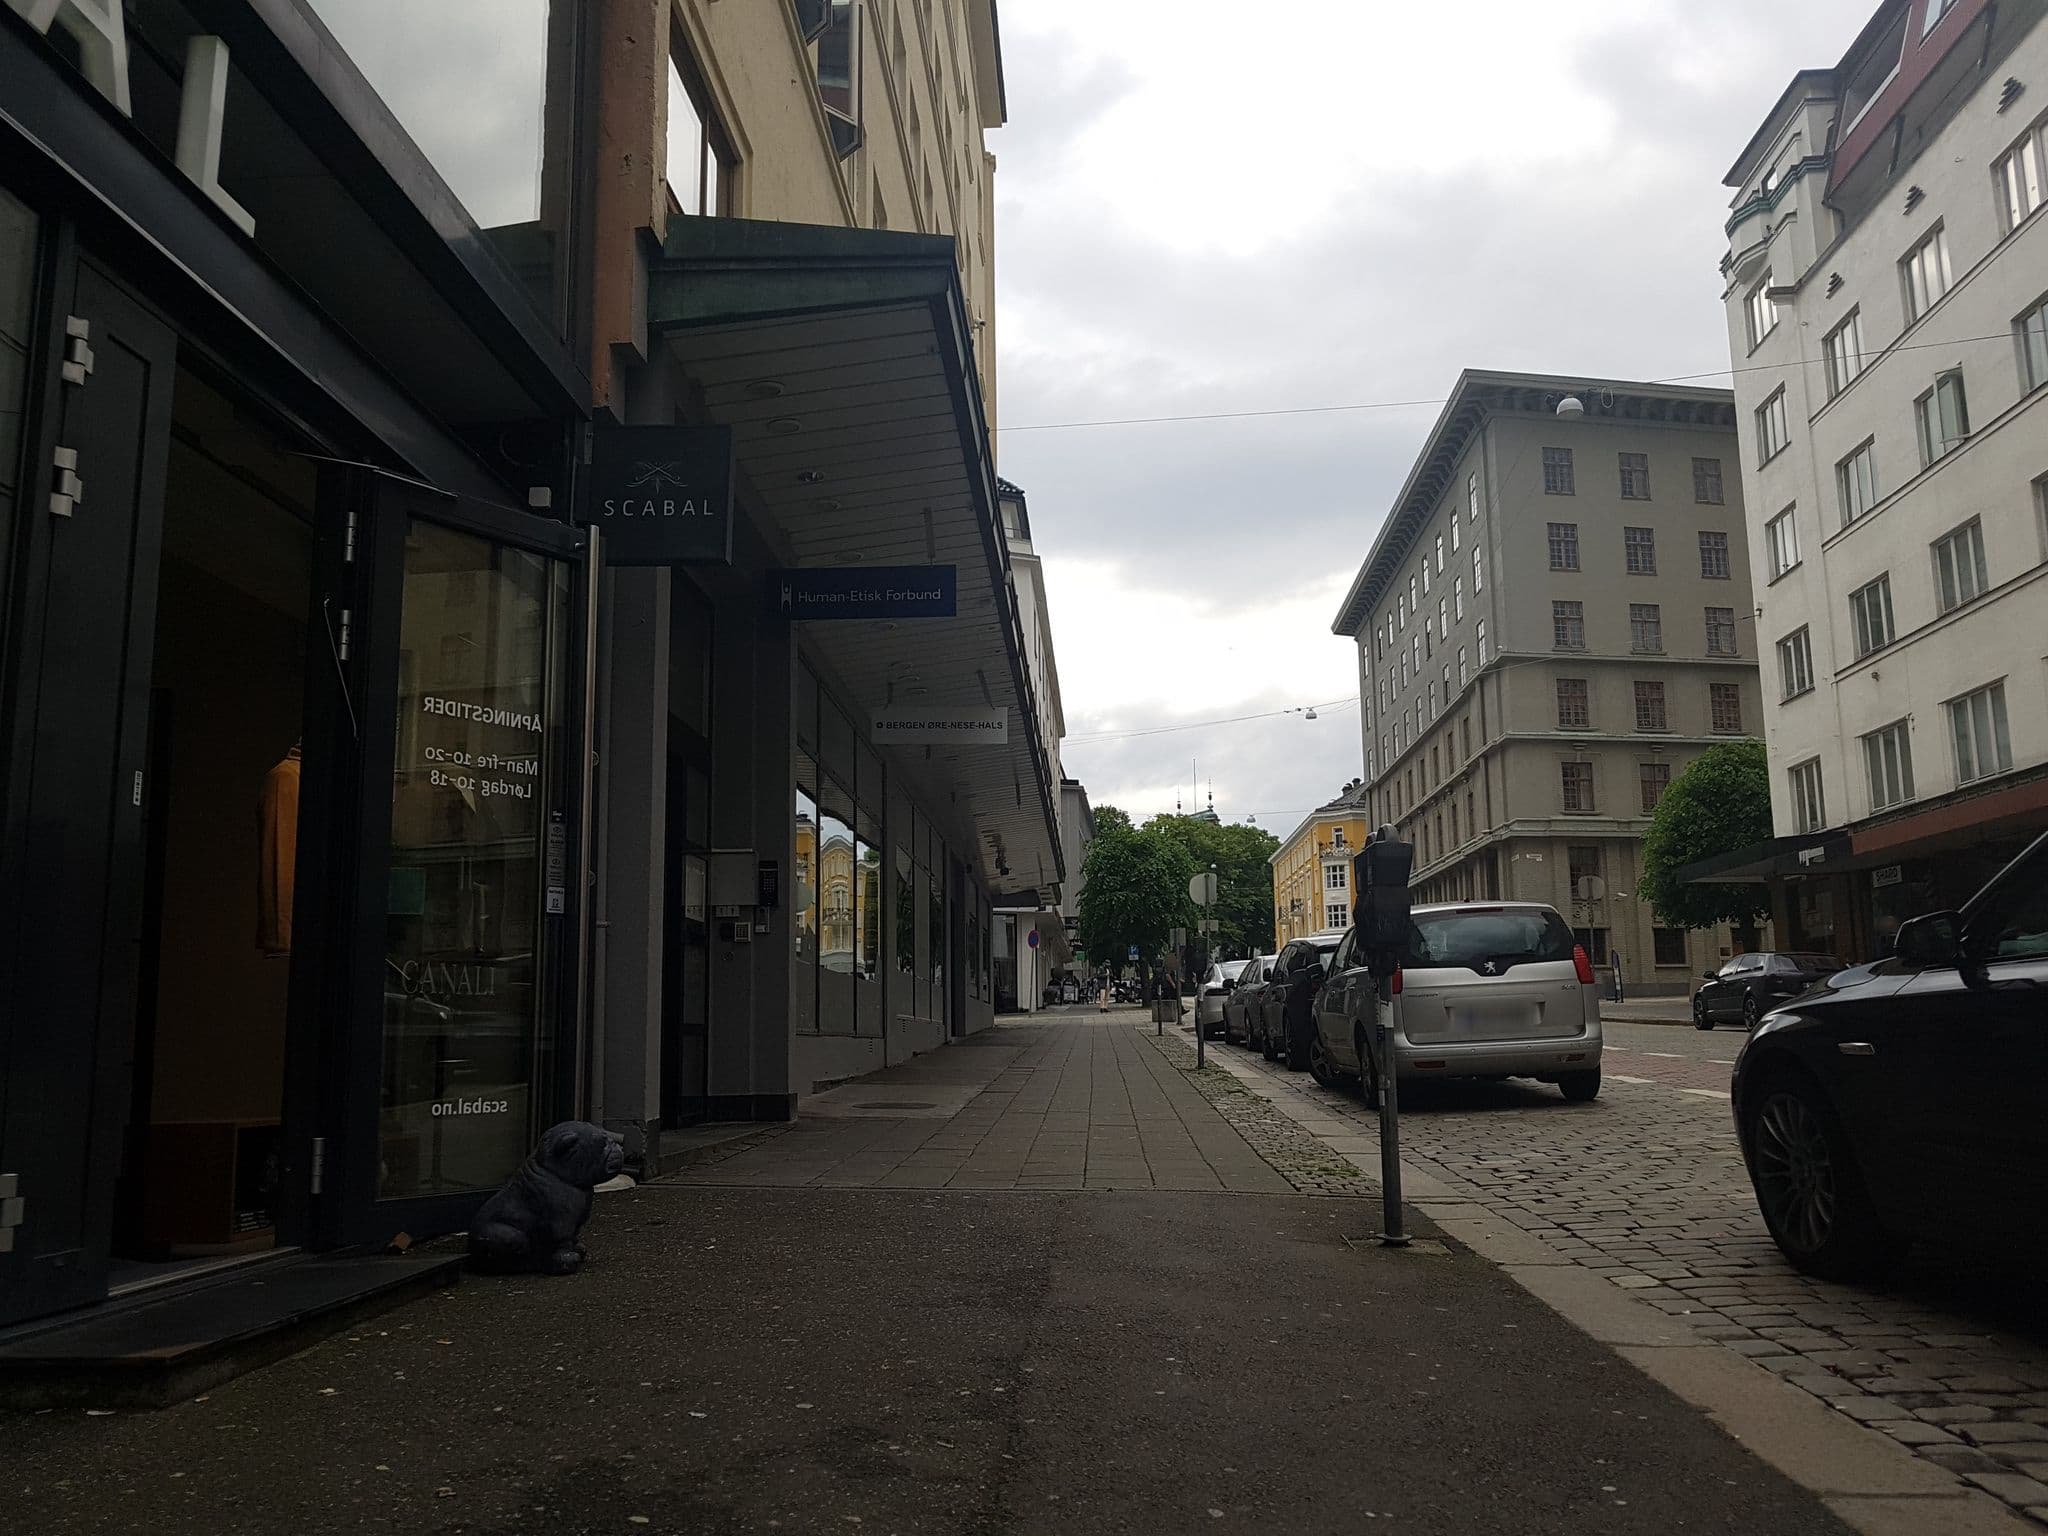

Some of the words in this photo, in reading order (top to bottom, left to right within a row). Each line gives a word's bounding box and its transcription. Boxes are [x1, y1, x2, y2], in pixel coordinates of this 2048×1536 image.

[603, 498, 715, 517] SCABAL
[798, 588, 881, 604] Human-Etisk
[886, 586, 942, 602] Forbund
[885, 720, 926, 730] BERGEN
[927, 720, 1003, 730] ØRE-NESE-HALS
[402, 959, 497, 997] CANALI
